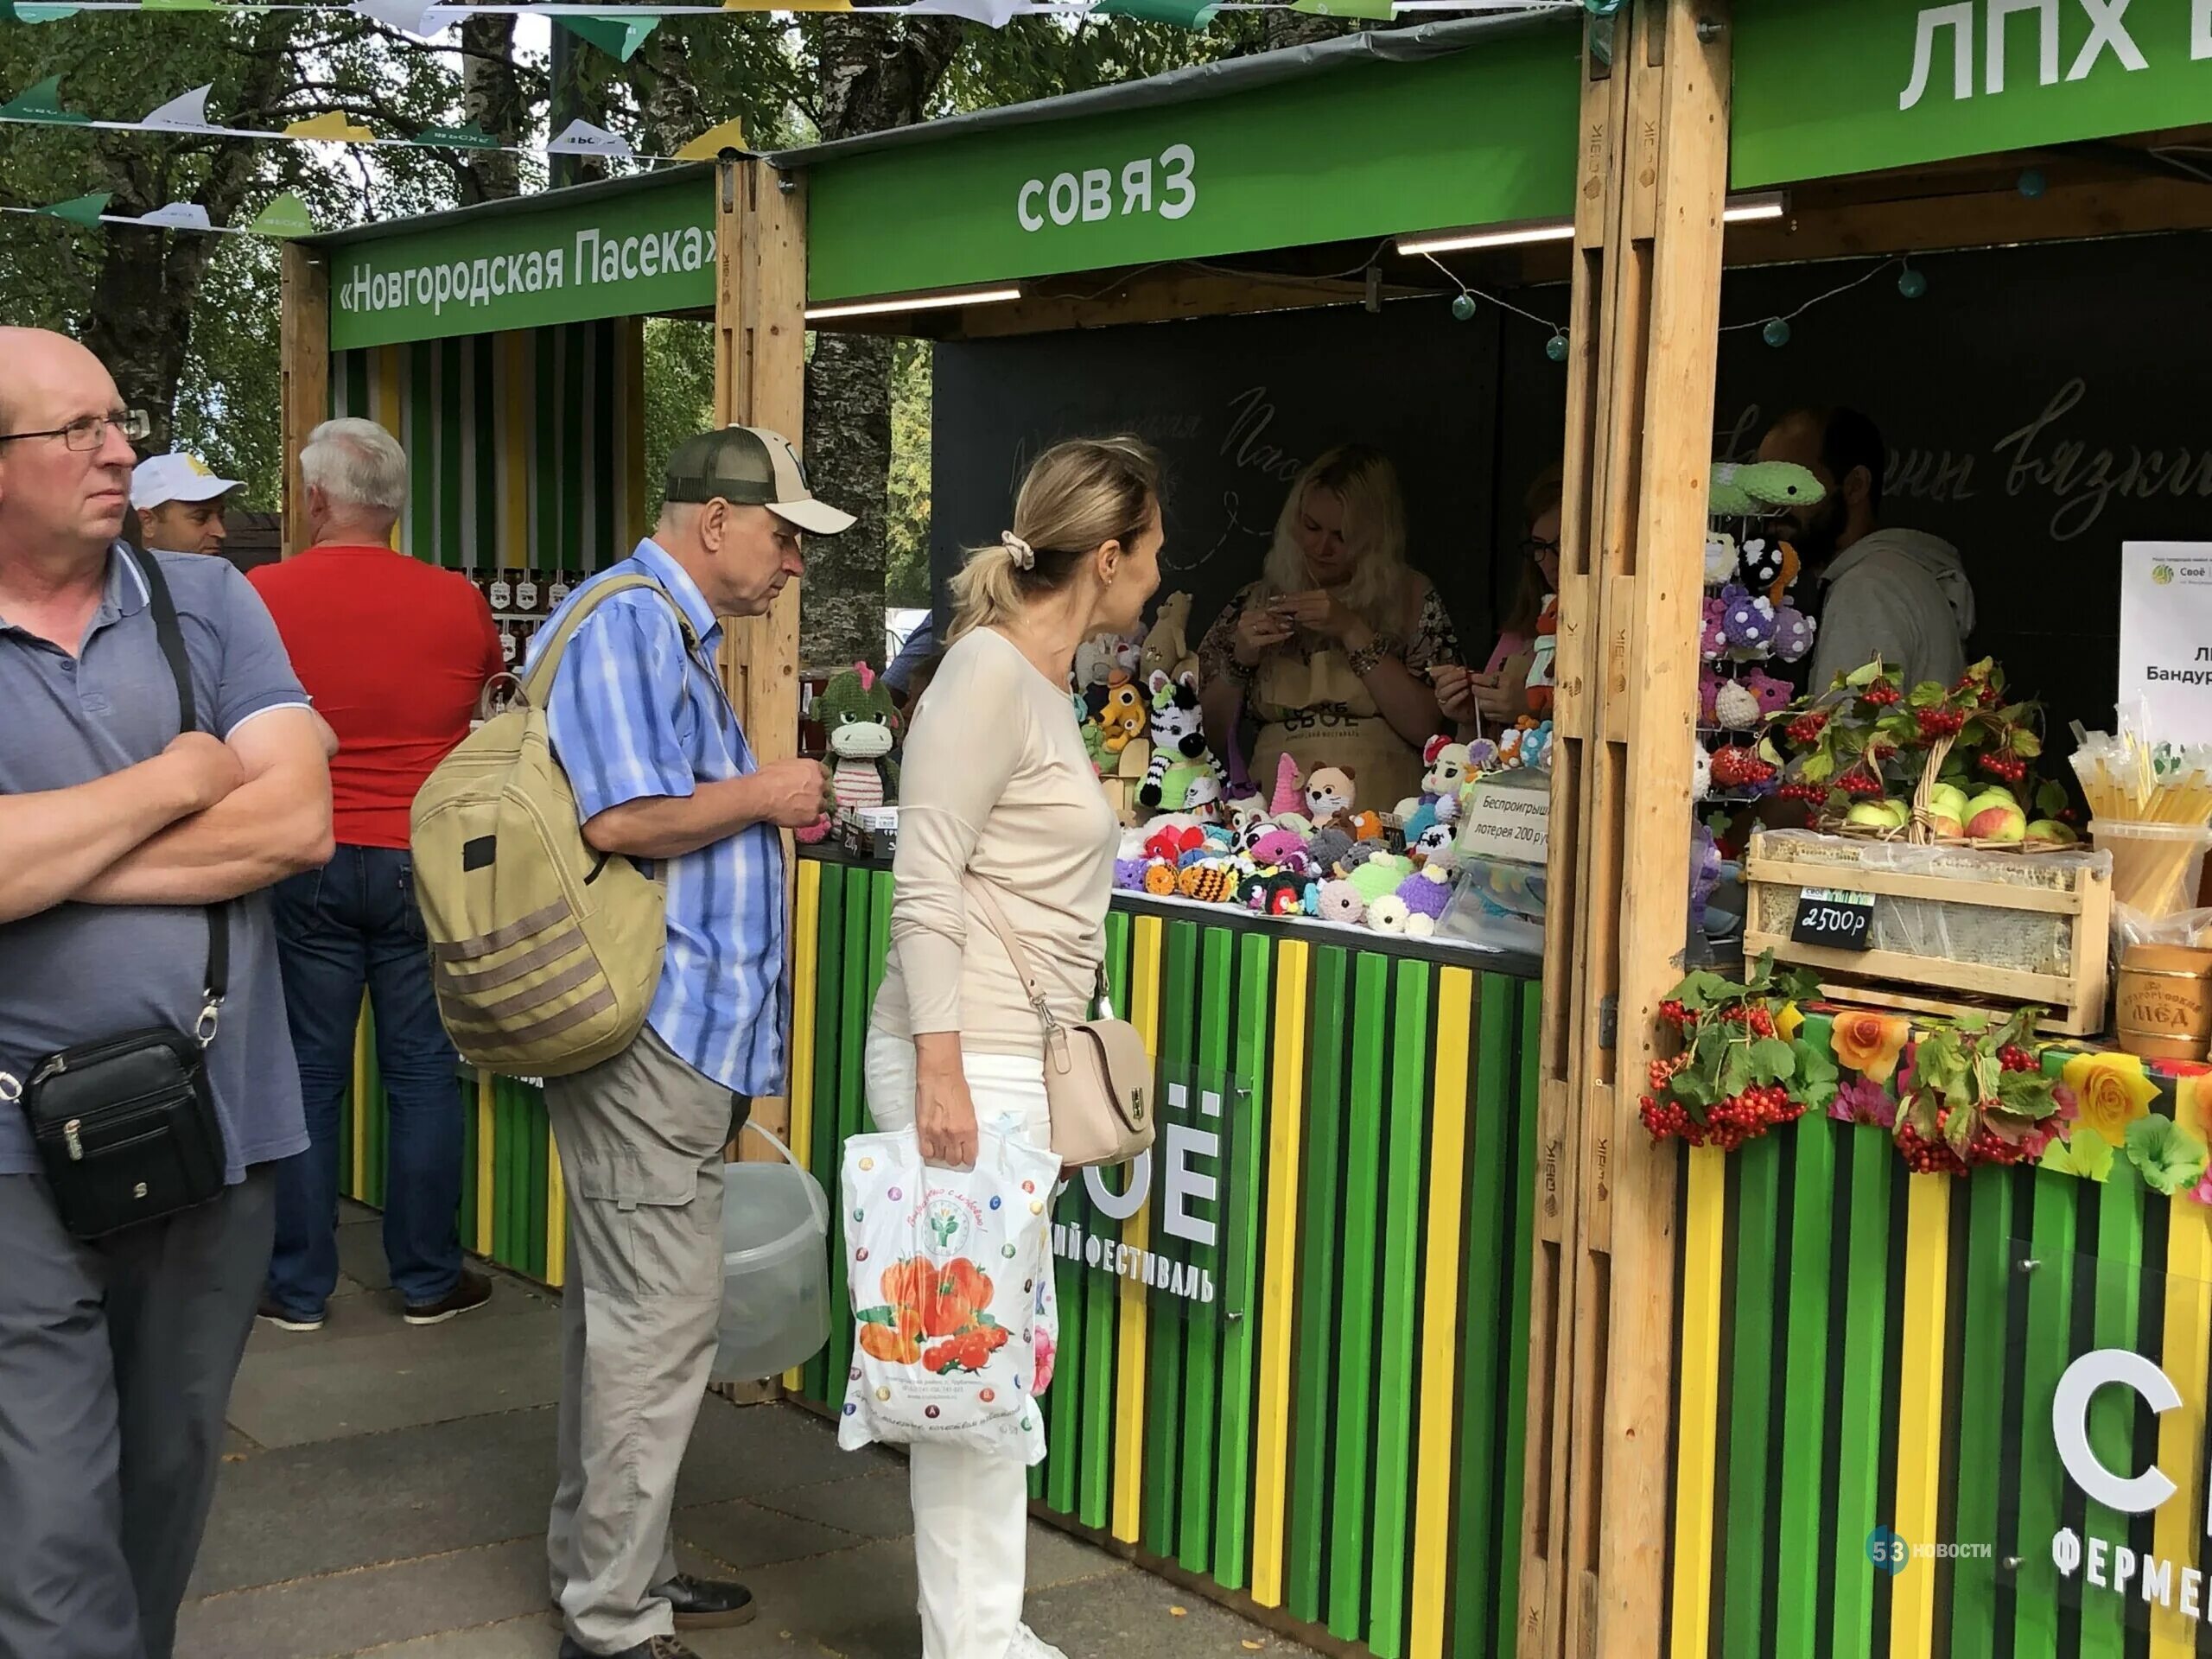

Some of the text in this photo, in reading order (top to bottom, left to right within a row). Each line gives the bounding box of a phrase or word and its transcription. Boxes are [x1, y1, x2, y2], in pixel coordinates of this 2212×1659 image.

[1900, 0, 2150, 111] ЛПХ
[340, 226, 716, 315] «Новгородская Пасека»
[2180, 567, 2205, 576] Своё
[2195, 647, 2212, 661] Л
[1483, 795, 1550, 816] Беспроигрыш
[1474, 823, 1513, 839] лотерея
[1515, 827, 1534, 841] 200
[1802, 907, 1865, 936] 2500р
[2132, 1003, 2189, 1028] МЁД
[1056, 1082, 1221, 1247] ОЁ
[1085, 1234, 1215, 1304] ФЕСТИВАЛЬ
[2052, 1348, 2212, 1536] С
[2052, 1528, 2212, 1623] ФЕРМЕ
